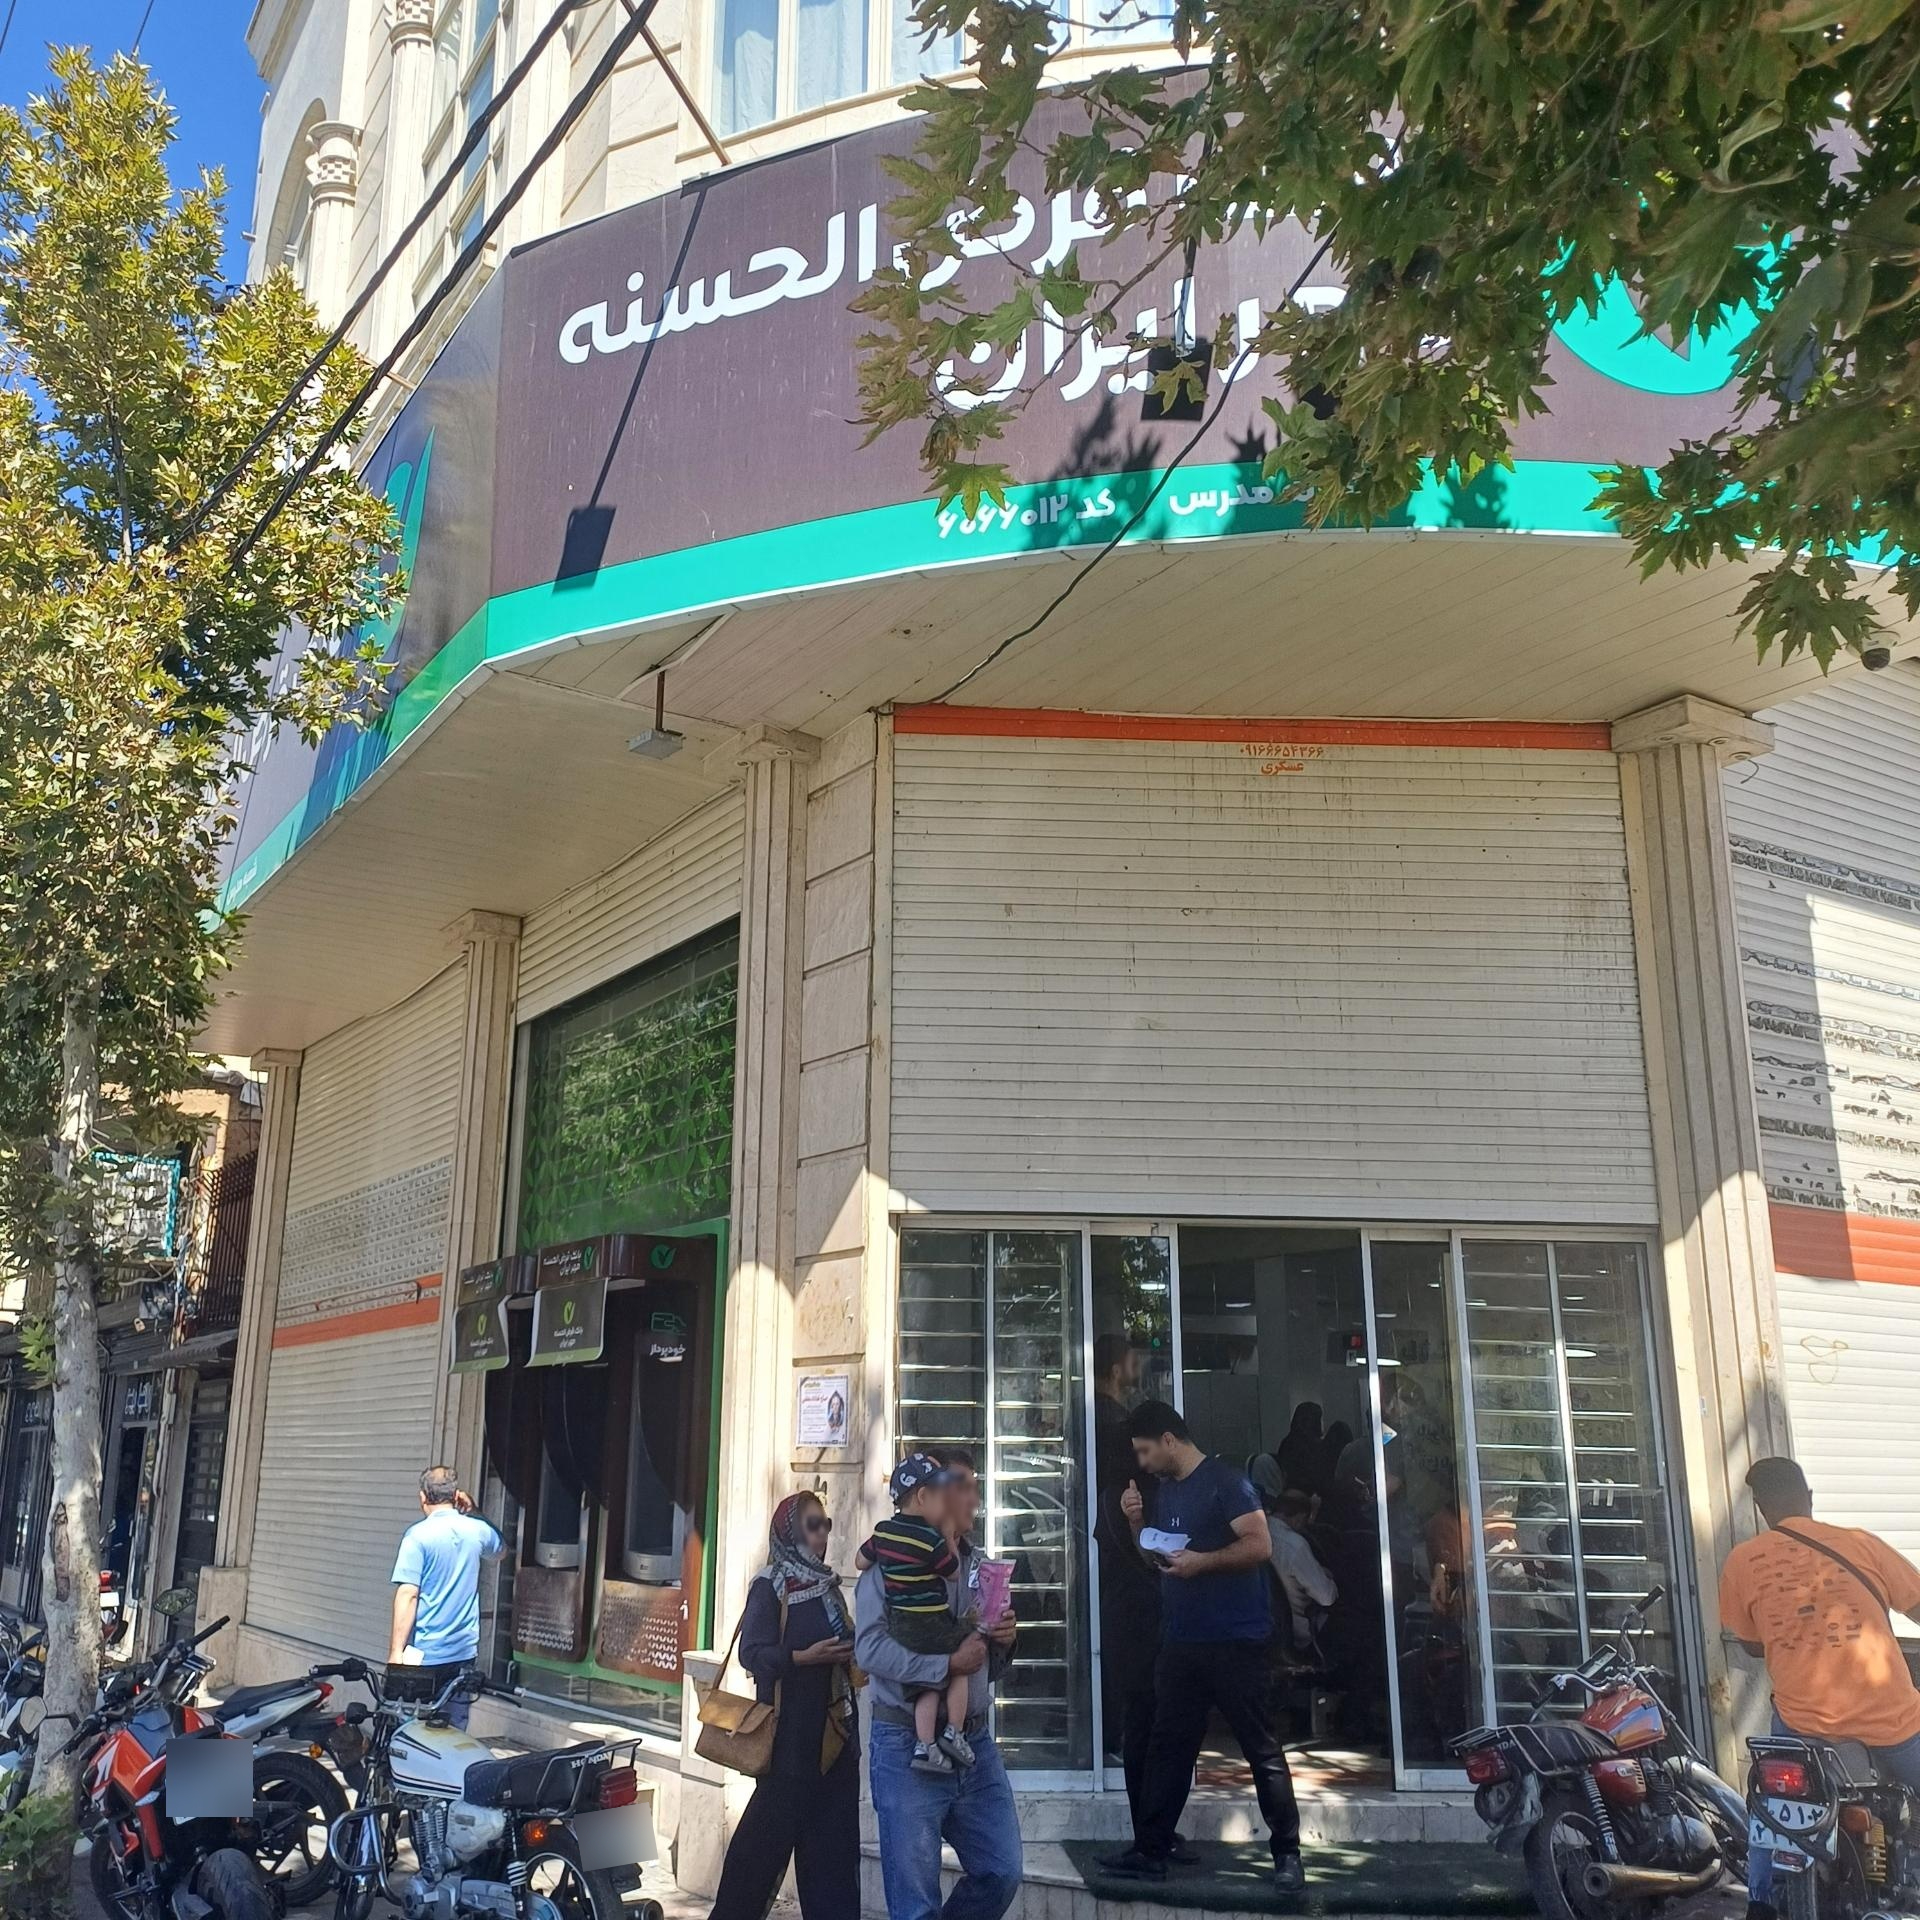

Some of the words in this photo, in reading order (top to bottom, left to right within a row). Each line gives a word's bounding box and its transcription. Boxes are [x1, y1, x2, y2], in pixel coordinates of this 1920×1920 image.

[558, 203, 877, 364] الحسنه
[934, 275, 1197, 411] ایران
[1076, 487, 1116, 519] کد
[1169, 484, 1274, 517] مدرس
[650, 1344, 686, 1357] خودپرداز
